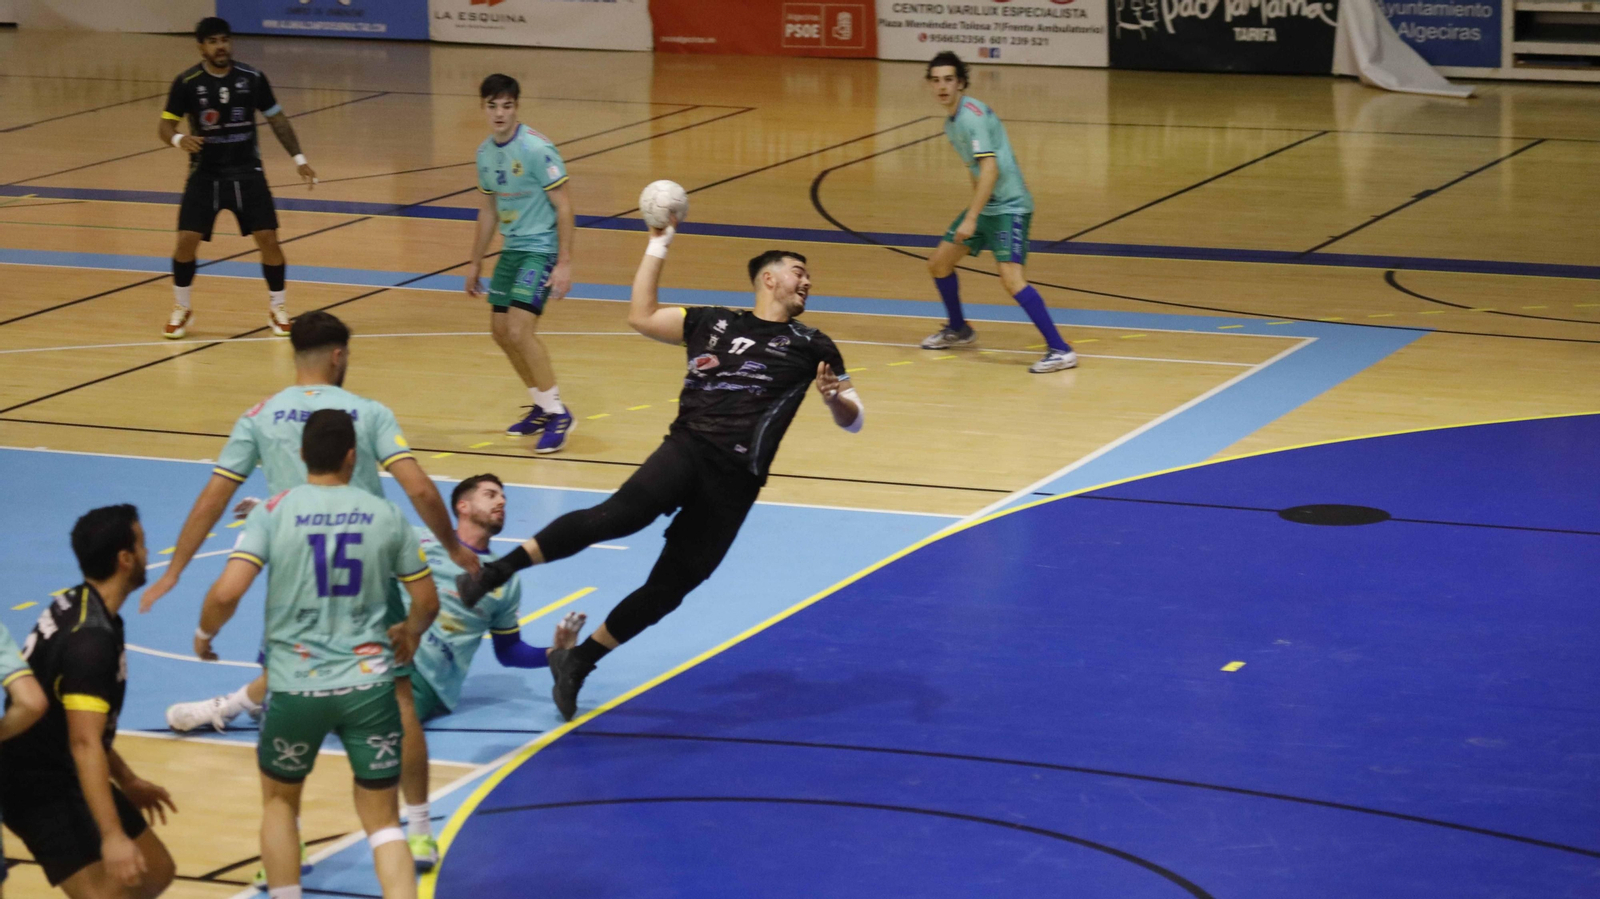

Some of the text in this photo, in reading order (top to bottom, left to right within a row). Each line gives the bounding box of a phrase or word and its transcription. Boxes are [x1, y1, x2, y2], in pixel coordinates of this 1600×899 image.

[434, 11, 527, 24] LA ESQUINA
[892, 3, 1087, 18] CENTRO VARILUX ESPECIALISTA
[785, 23, 821, 38] PSOE
[1232, 27, 1277, 42] TARIFA
[1397, 21, 1482, 43] Algeciras
[727, 336, 757, 356] 17
[294, 507, 375, 528] MOLDÓN
[307, 532, 364, 598] 15
